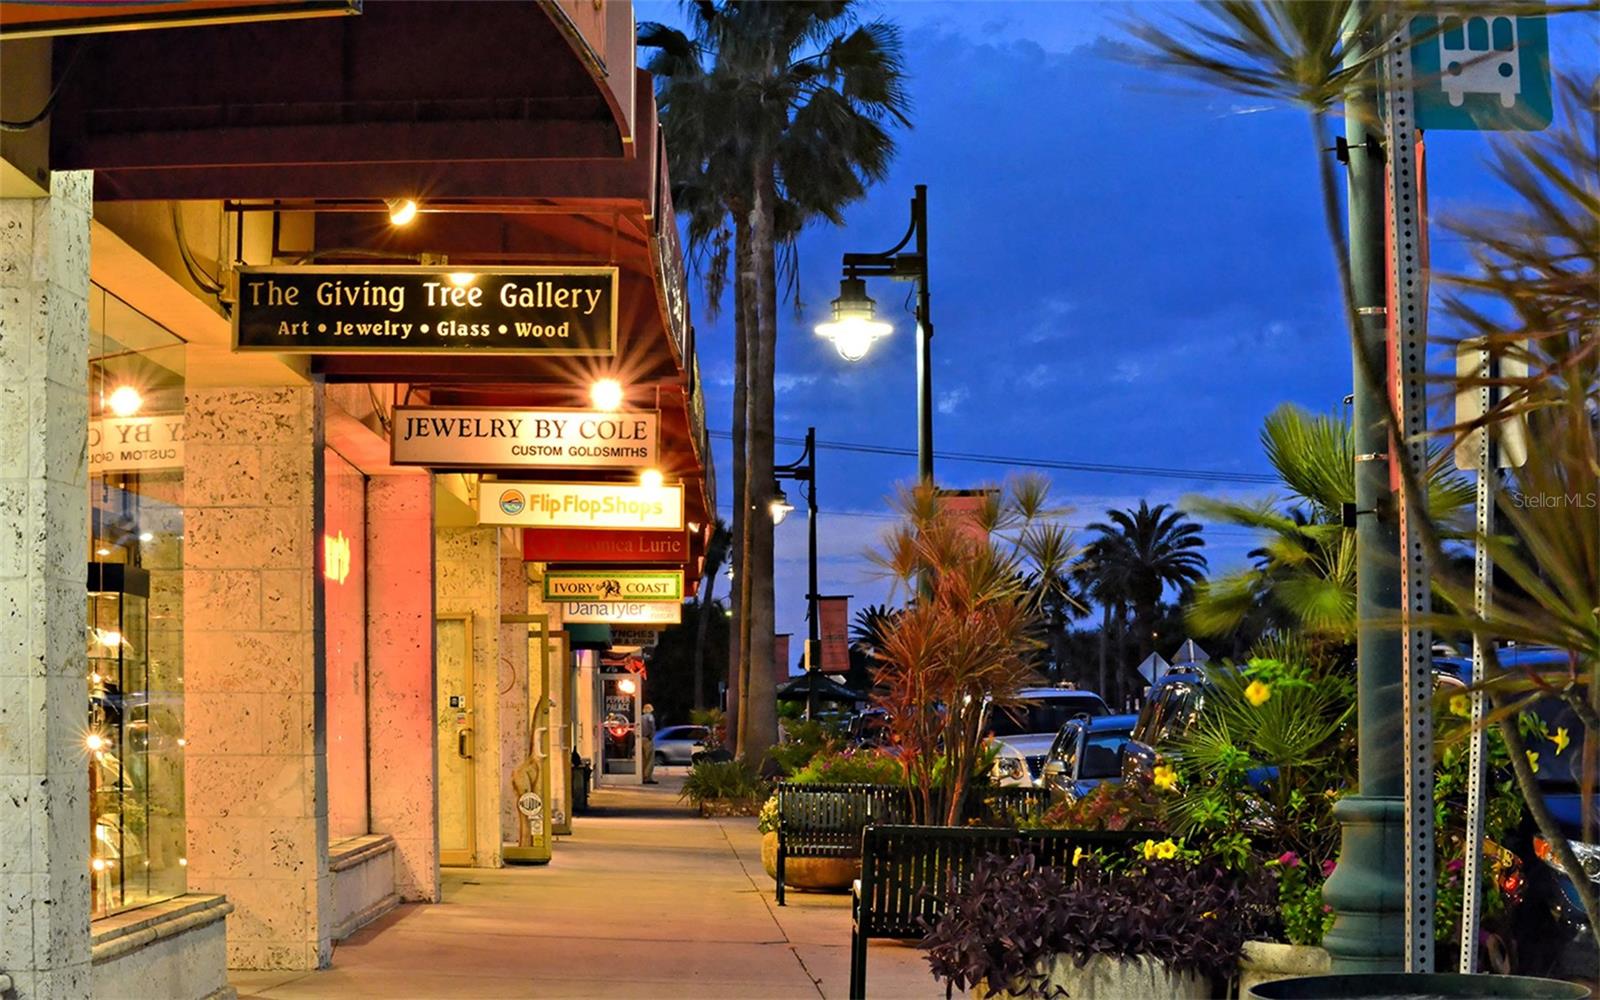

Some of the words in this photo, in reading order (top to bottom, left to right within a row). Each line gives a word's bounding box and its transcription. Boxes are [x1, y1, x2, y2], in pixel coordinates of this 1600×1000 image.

[248, 281, 299, 307] The
[316, 281, 405, 313] Giving
[422, 281, 483, 308] Tree
[500, 281, 602, 314] Gallery
[278, 321, 309, 337] Art
[333, 320, 413, 340] Jewelry
[437, 321, 490, 337] Glass
[514, 322, 569, 338] Wood
[404, 417, 523, 441] JEWELRY
[535, 419, 568, 440] BY
[579, 419, 648, 441] COLE
[511, 445, 563, 457] CUSTOM
[568, 446, 648, 458] GOLDSMITHS
[639, 536, 681, 553] Lurie
[554, 583, 594, 593] IVORY
[626, 583, 669, 593] COAST
[610, 629, 655, 638] YNCHES
